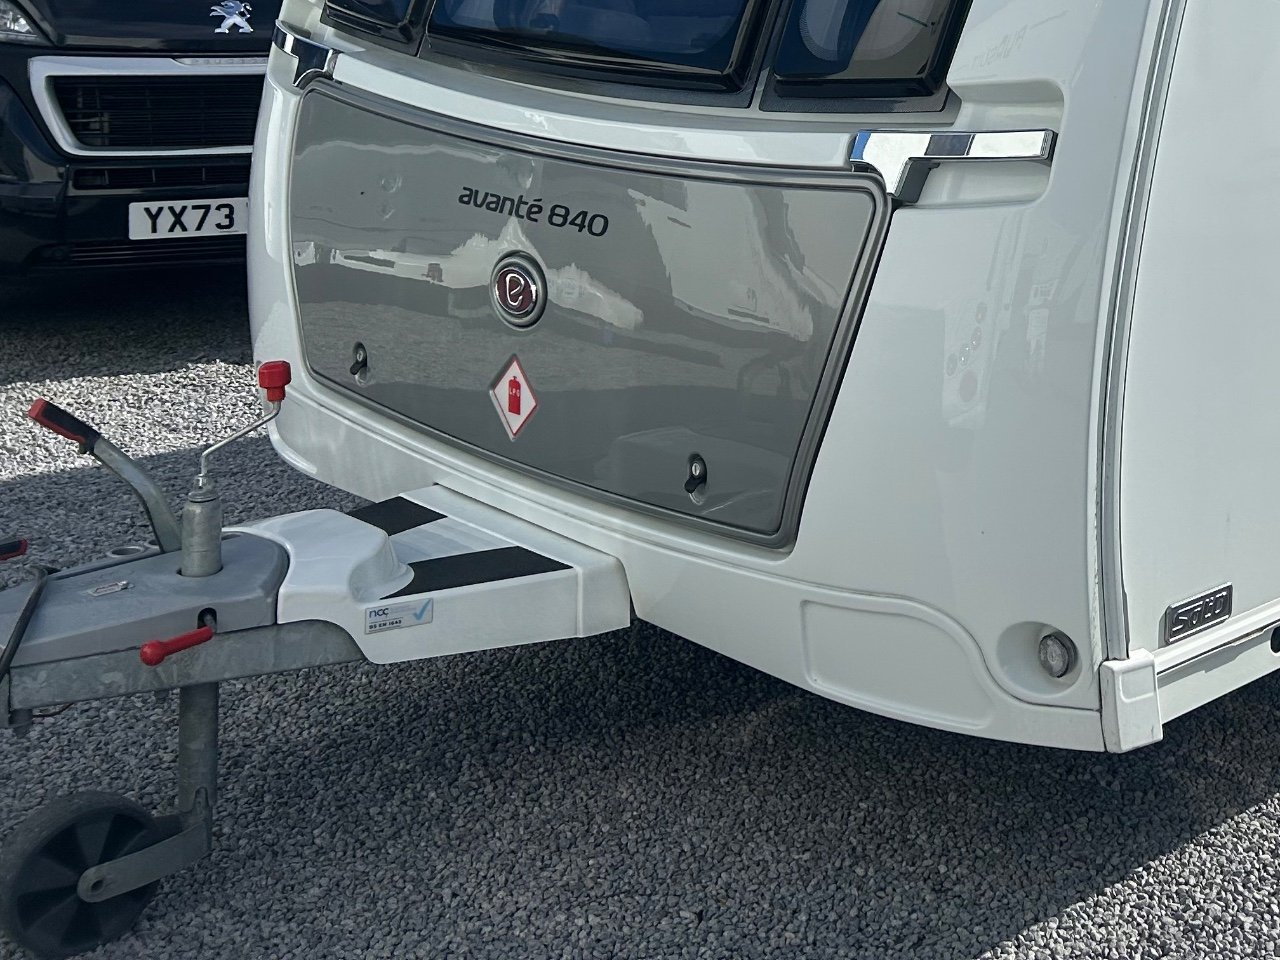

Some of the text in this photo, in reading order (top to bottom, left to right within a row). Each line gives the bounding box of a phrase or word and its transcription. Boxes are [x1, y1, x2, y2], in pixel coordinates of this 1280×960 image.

[143, 203, 235, 233] YX73
[458, 186, 609, 237] avanté 840
